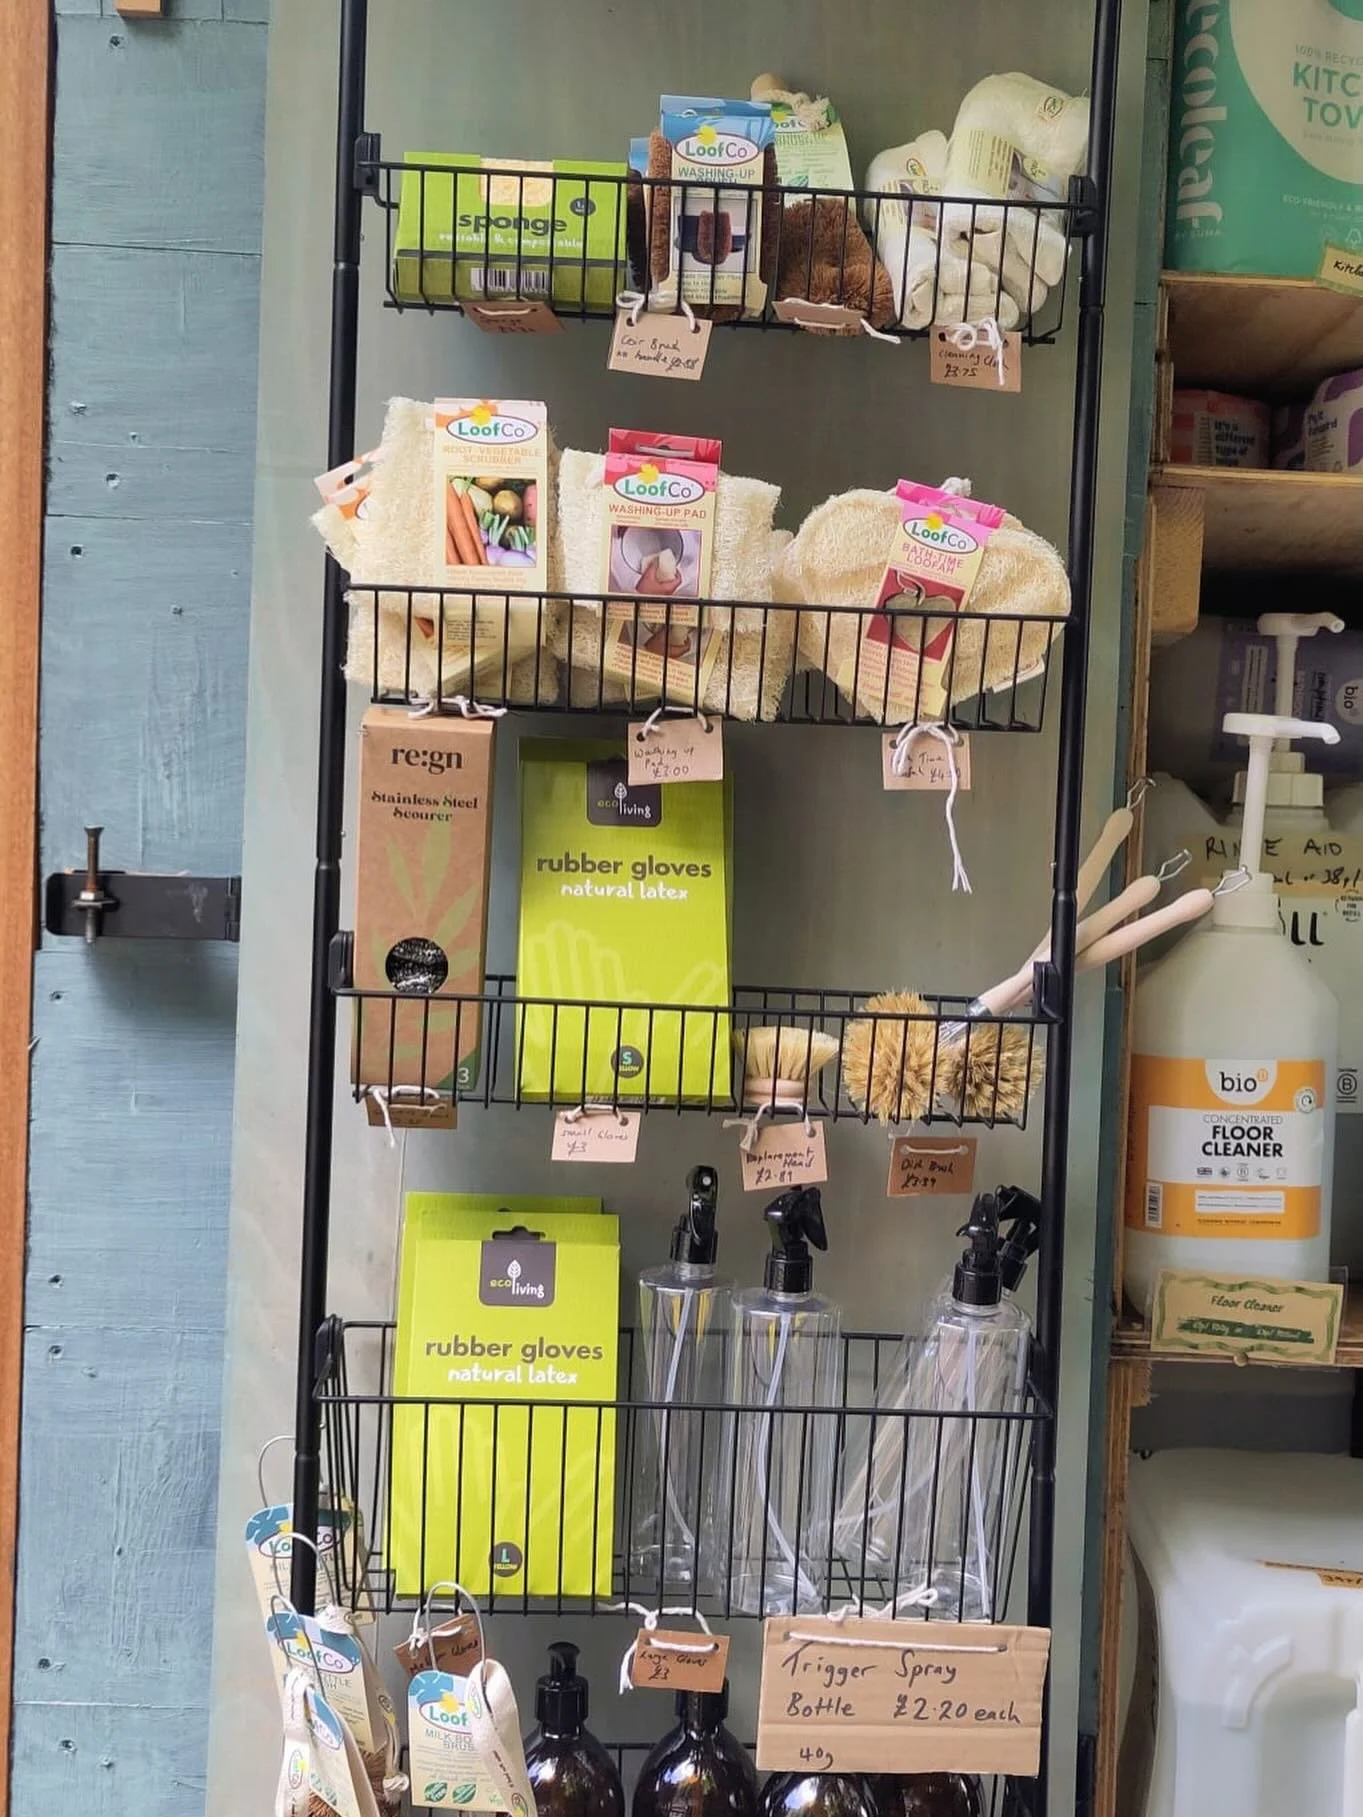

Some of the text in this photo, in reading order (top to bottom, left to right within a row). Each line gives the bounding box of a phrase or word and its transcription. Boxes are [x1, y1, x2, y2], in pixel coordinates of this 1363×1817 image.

[1177, 0, 1228, 228] ecoleaf
[685, 141, 748, 159] LoofCo
[678, 167, 755, 179] WASHING-UP
[459, 214, 567, 236] sponge
[494, 235, 504, 245] &
[458, 421, 525, 438] LoofCo
[624, 480, 692, 498] LoofCo
[608, 504, 707, 519] WASHING-UP PAD
[912, 522, 967, 550] LoofCo
[391, 748, 463, 775] re:gn
[371, 791, 479, 809] Stainless Steel
[598, 800, 618, 808] eco
[392, 806, 453, 822] Scourer
[1304, 838, 1342, 856] AID
[537, 852, 712, 880] rubber gloves
[560, 880, 689, 900] natural latex
[622, 1051, 633, 1065] S
[457, 1067, 470, 1083] 3
[1202, 1114, 1283, 1125] CONCENTRATED
[1211, 1125, 1274, 1141] FLOOR
[1201, 1141, 1283, 1158] CLEANER
[490, 1277, 512, 1288] eco
[1211, 1295, 1285, 1313] Floor Cleaner
[426, 1335, 604, 1363] rubber gloves
[447, 1364, 578, 1384] natural latex
[500, 1549, 511, 1564] L
[782, 1641, 957, 1688] Trigger Spray
[786, 1691, 1021, 1724] Bottle £2.20 each
[799, 1746, 834, 1771] 40g
